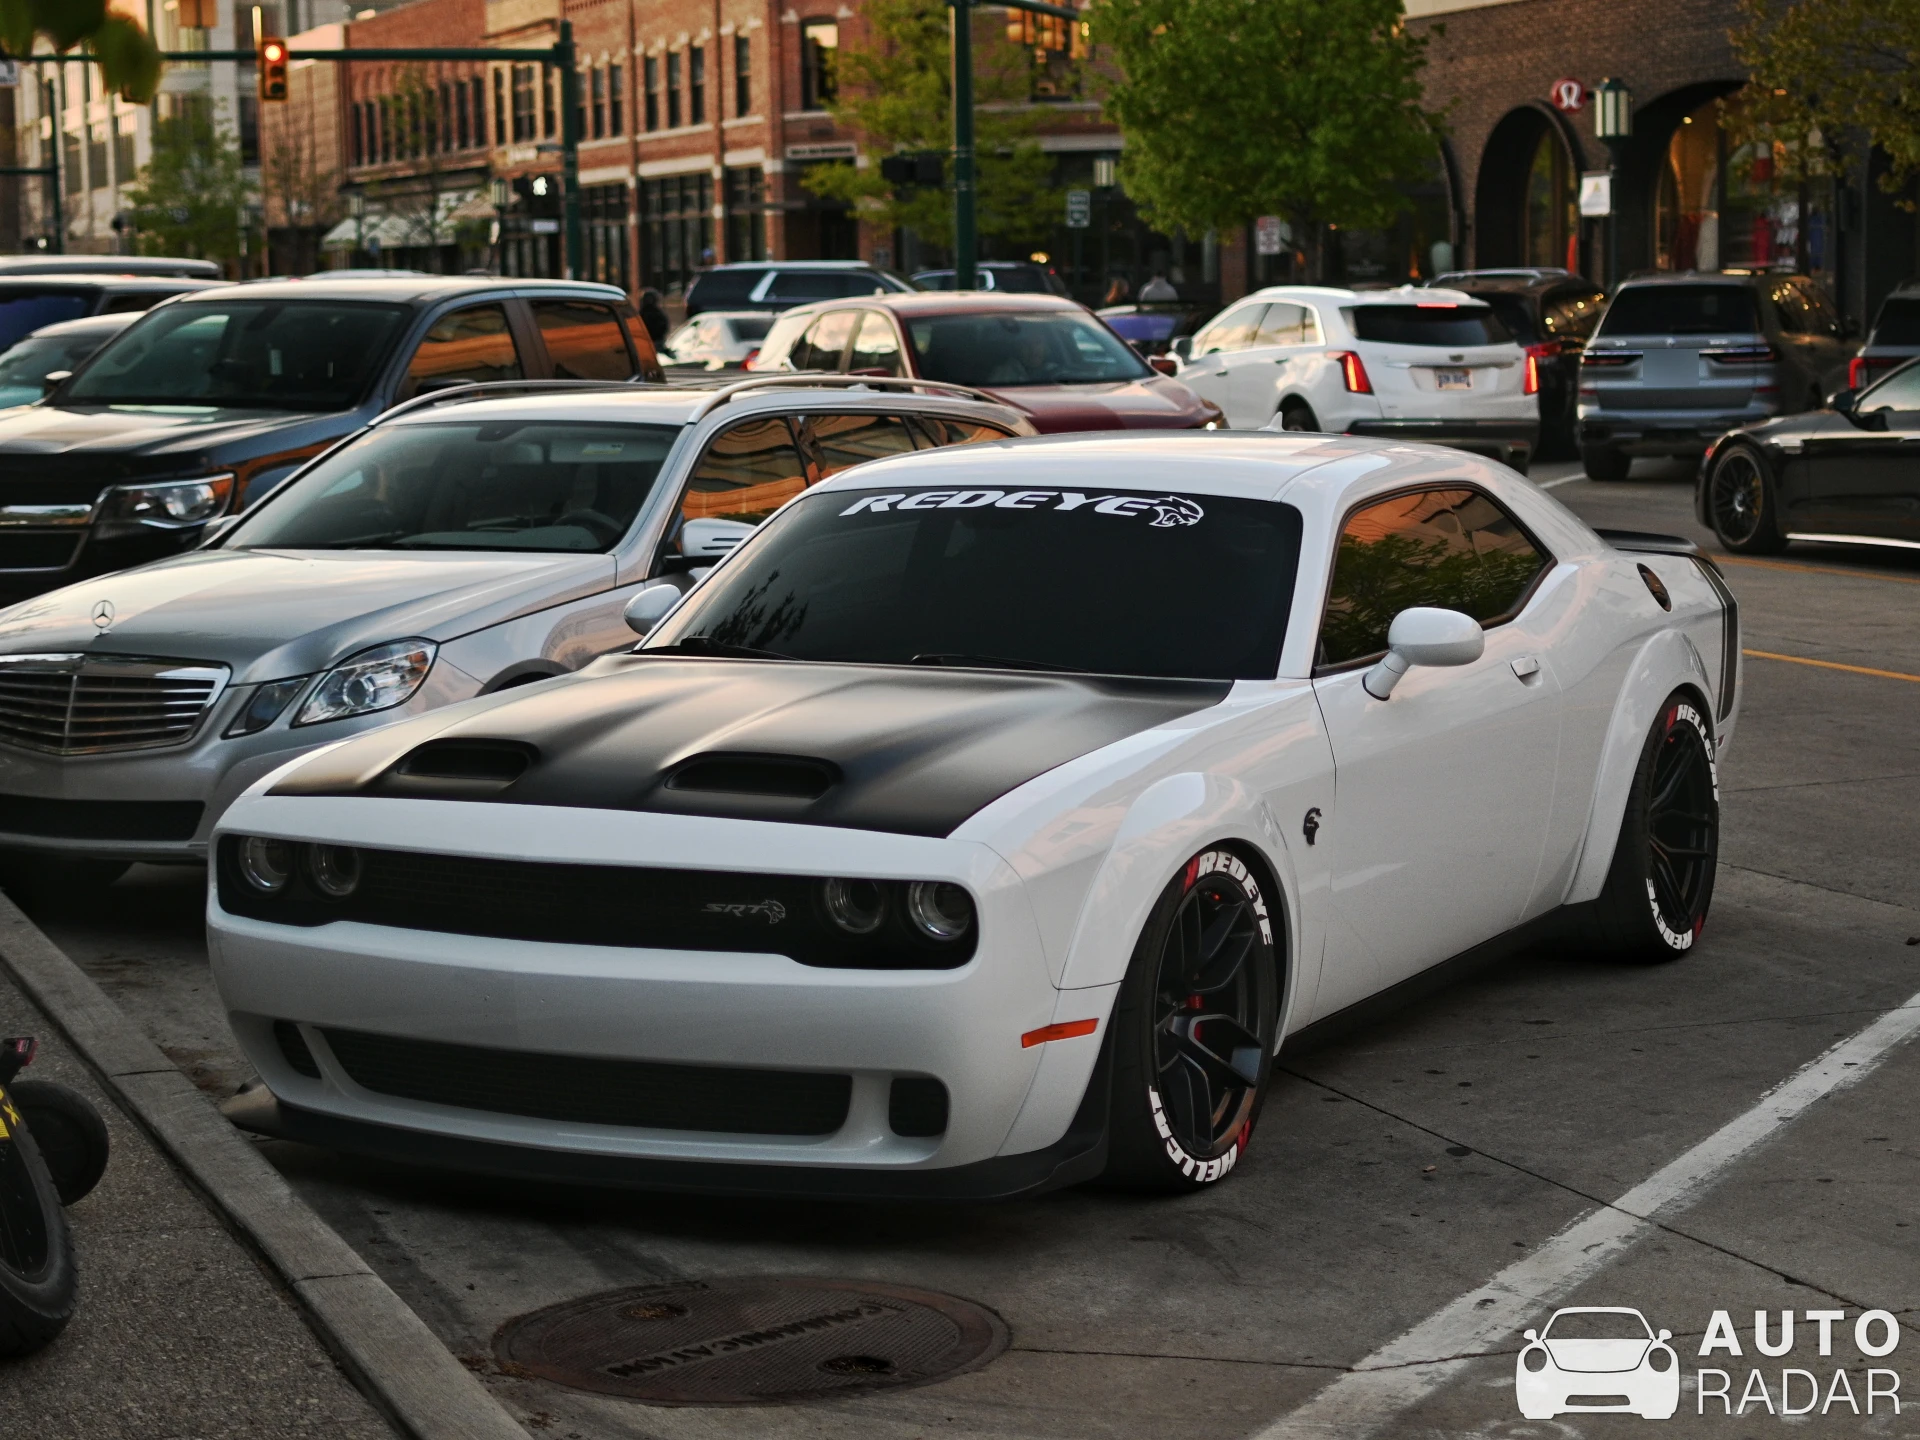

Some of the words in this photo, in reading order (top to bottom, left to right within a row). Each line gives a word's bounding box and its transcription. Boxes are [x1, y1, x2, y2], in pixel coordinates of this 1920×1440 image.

[838, 490, 1161, 517] REDEYE
[701, 903, 768, 917] SRT
[1198, 851, 1273, 945] REDEYE
[1646, 878, 1693, 950] REDEYE
[1148, 1085, 1237, 1182] HELLCAT
